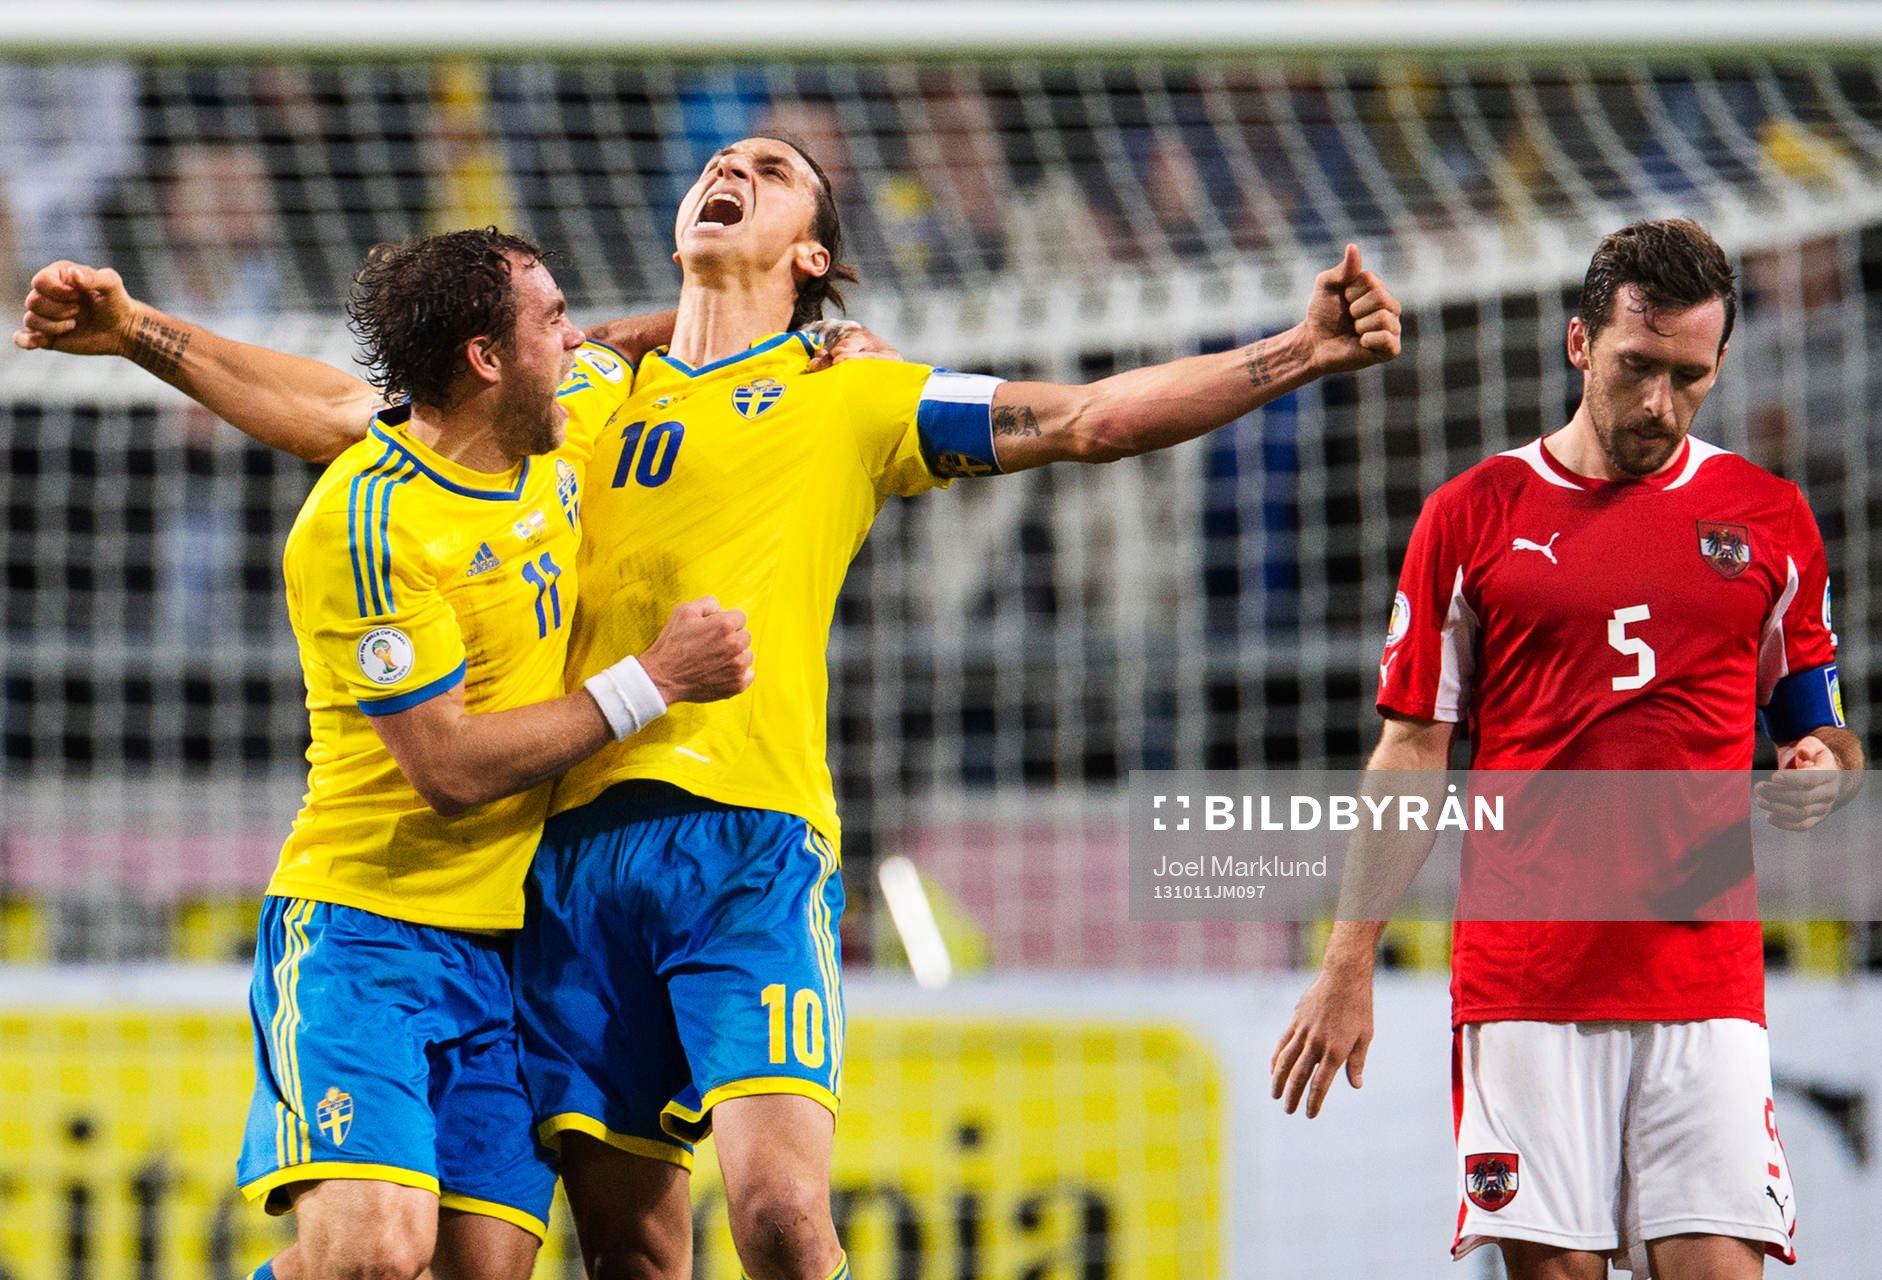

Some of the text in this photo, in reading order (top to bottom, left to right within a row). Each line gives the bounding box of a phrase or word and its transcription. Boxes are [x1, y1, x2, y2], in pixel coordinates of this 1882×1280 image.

[611, 421, 685, 488] 10
[521, 551, 561, 639] 11
[1608, 604, 1656, 691] 5
[761, 984, 824, 1069] 10
